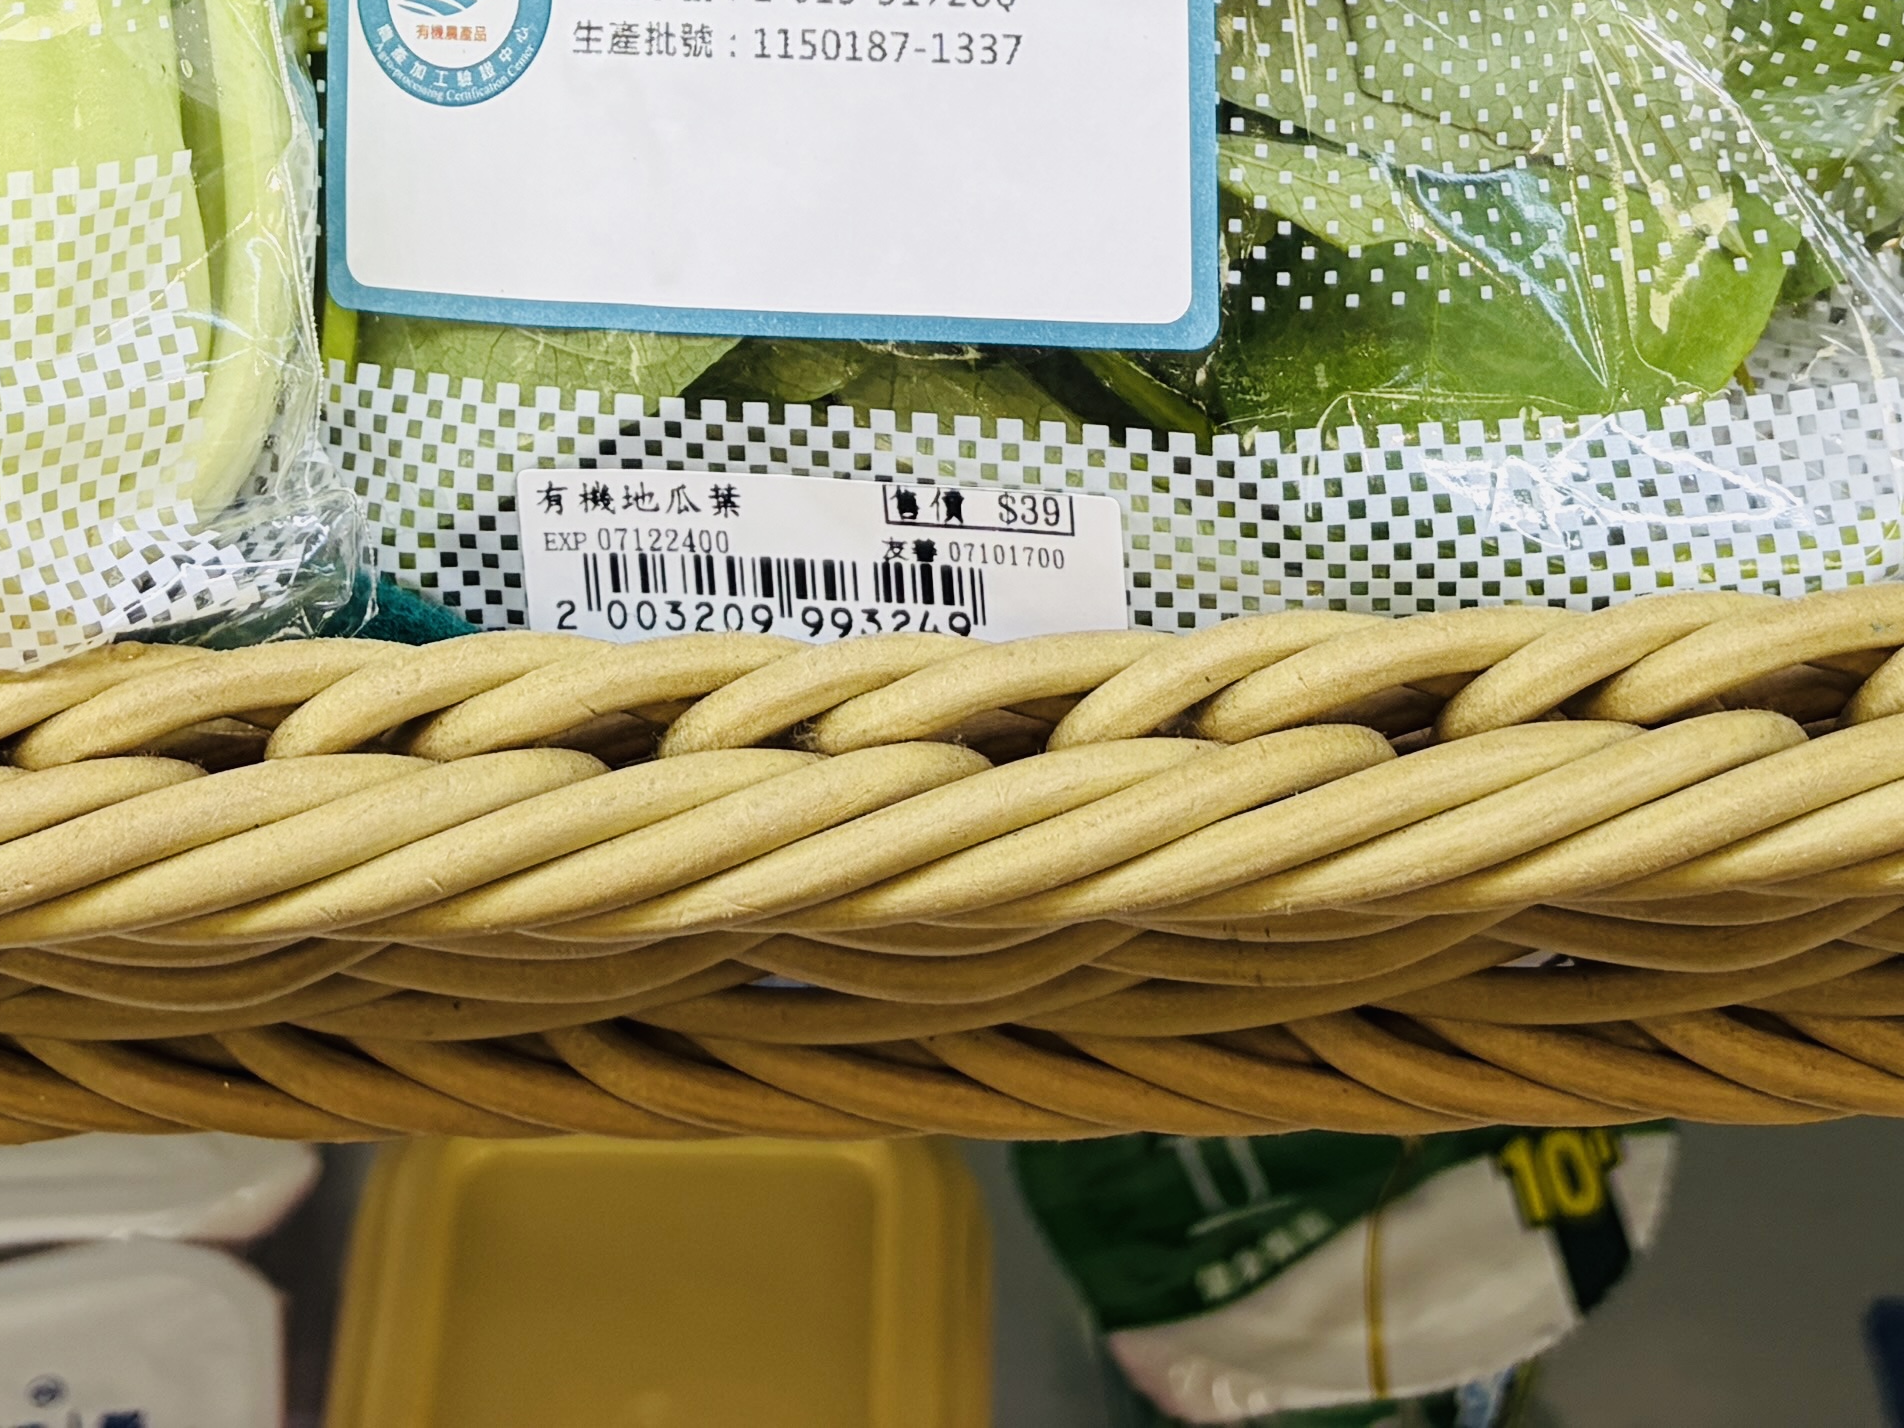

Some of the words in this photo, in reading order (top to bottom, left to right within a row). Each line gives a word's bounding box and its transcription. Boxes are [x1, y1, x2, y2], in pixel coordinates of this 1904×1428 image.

[535, 479, 743, 519] 有機地瓜葉
[997, 490, 1062, 528] $39
[543, 531, 588, 553] EXP
[596, 527, 730, 554] 07122400
[947, 540, 1066, 571] 07101700
[555, 599, 579, 631] 2
[606, 599, 775, 636] 003209
